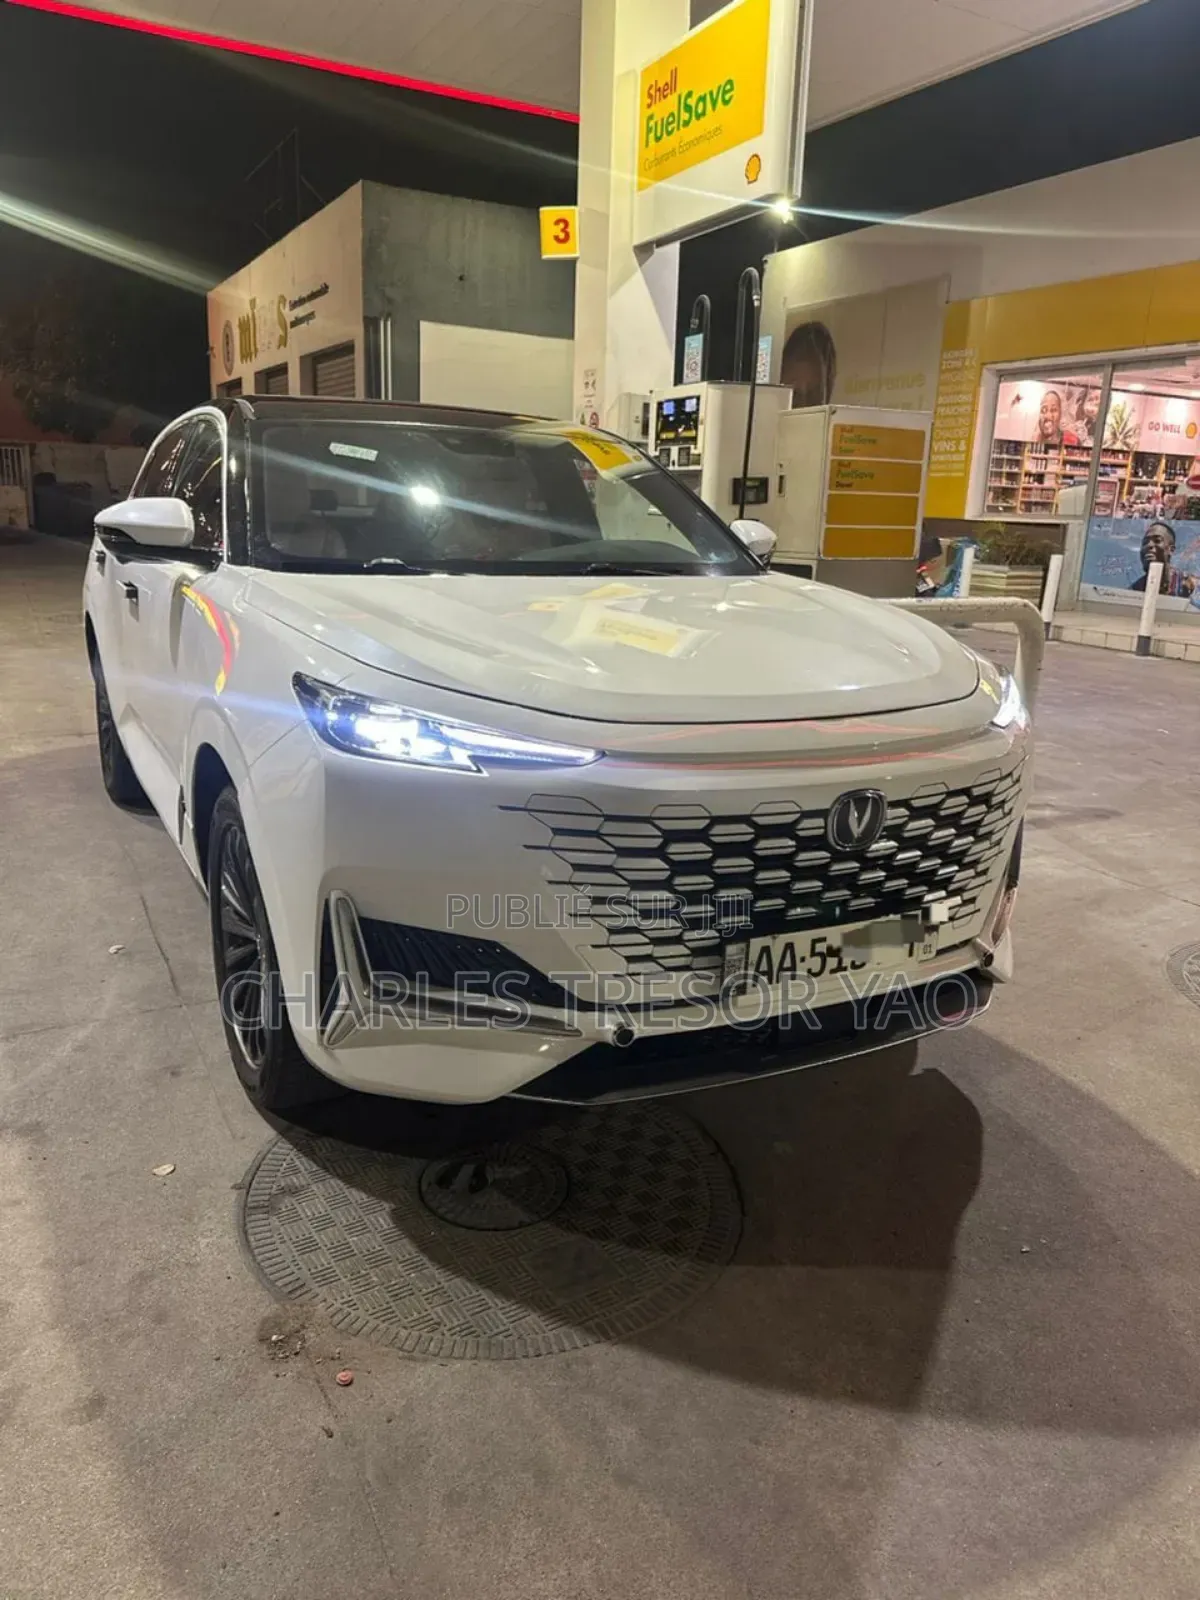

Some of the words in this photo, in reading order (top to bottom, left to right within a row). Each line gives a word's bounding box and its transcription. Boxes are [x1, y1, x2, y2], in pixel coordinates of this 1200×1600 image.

[646, 66, 677, 109] Shell
[645, 78, 735, 148] FuelSave
[553, 218, 570, 244] 3
[1148, 421, 1161, 431] GO
[1162, 423, 1181, 434] WELL
[933, 440, 956, 452] VINS
